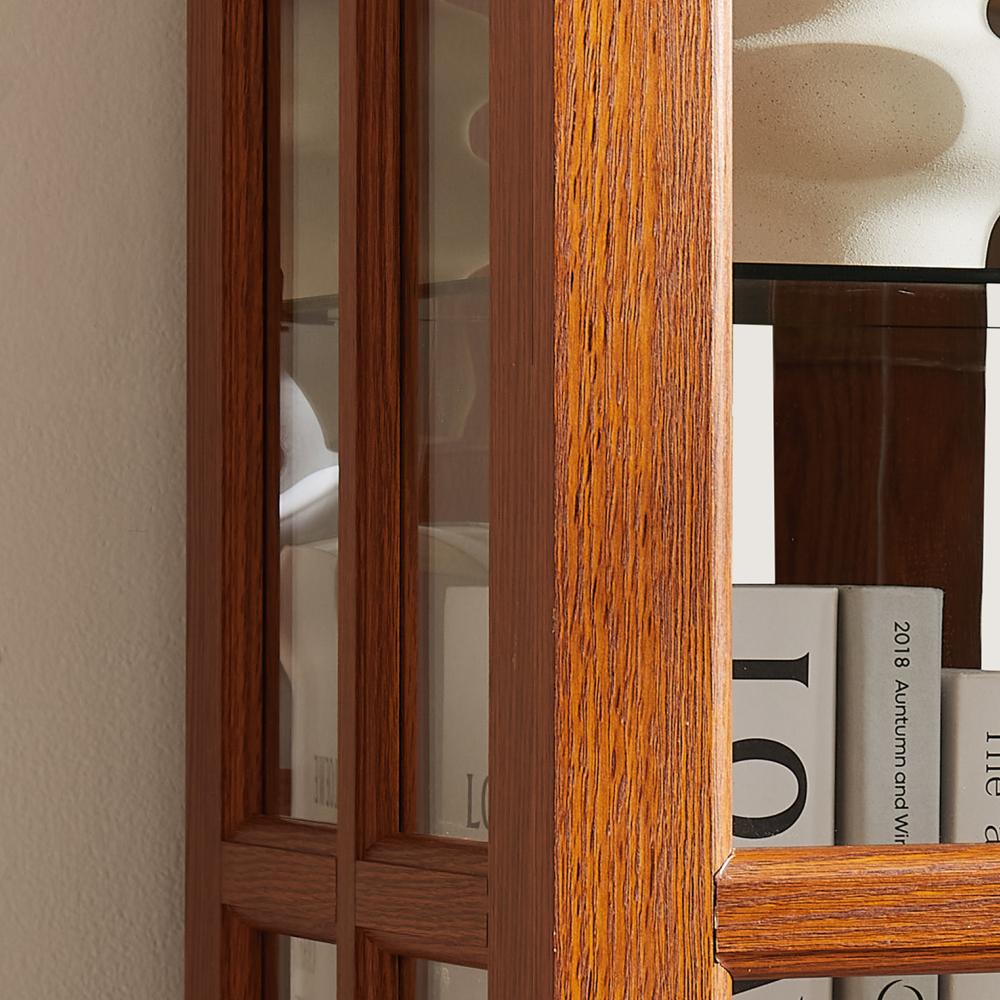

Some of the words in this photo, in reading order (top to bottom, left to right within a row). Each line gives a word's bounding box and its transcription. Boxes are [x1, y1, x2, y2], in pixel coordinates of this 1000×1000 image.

[893, 620, 910, 668] 2018
[893, 679, 910, 768] Auntumn
[893, 772, 909, 810] and
